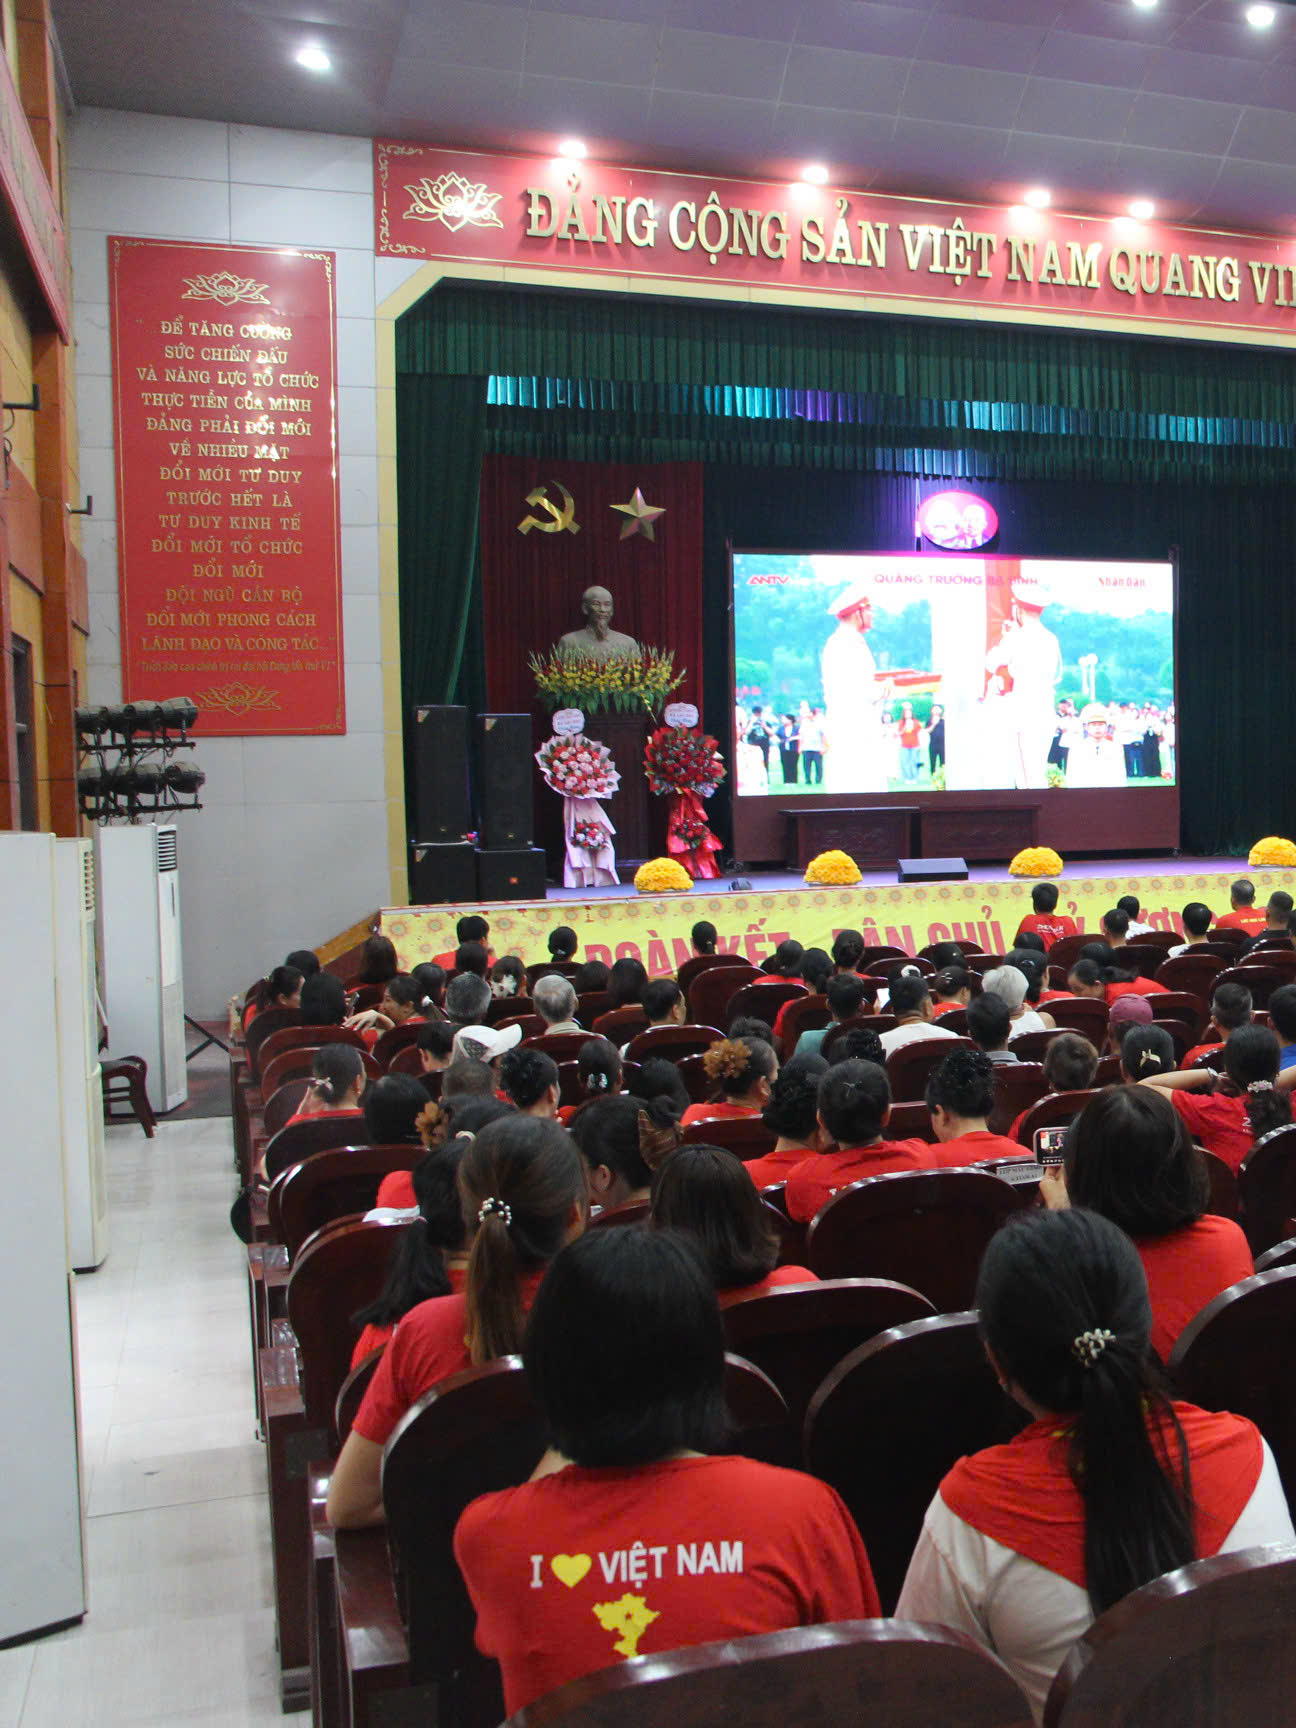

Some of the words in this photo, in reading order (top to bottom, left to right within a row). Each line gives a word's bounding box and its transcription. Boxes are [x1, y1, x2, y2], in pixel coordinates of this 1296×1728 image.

[525, 172, 659, 248] ĐẢNG
[668, 191, 791, 265] CỘNG
[801, 197, 888, 269] SẢN
[899, 217, 998, 287] VIỆT
[1006, 237, 1103, 288] NAM
[1109, 246, 1241, 303] QUANG
[161, 314, 183, 334] ĐỂ
[189, 322, 234, 337] TĂNG
[164, 342, 195, 359] SỨC
[201, 344, 251, 362] CHIẾN
[136, 364, 157, 381] VÀ
[165, 368, 210, 384] NĂNG
[217, 371, 247, 387] LỰC
[252, 367, 273, 386] TỔ
[279, 371, 320, 389] CHỨC
[142, 393, 184, 411] THỰC
[269, 395, 312, 412] MÌNH
[147, 412, 192, 432] ĐẢNG
[200, 415, 240, 434] PHẢI
[170, 439, 191, 456] VỀ
[198, 439, 248, 458] NHIỀU
[160, 460, 191, 480] ĐỔI
[198, 465, 230, 481] MỚI
[240, 468, 262, 482] TƯ
[268, 470, 302, 483] DUY
[167, 490, 221, 504] TRƯỚC
[231, 489, 263, 506] HẾT
[273, 491, 293, 507] LÀ
[159, 515, 181, 528] TƯ
[189, 516, 222, 528] DUY
[229, 517, 271, 529] KINH
[152, 532, 182, 552] ĐỔI
[191, 536, 222, 553] MỚI
[259, 538, 303, 554] CHỨC
[193, 556, 223, 577] ĐỔI
[232, 559, 264, 578] MỚI
[217, 613, 270, 627] PHONG
[530, 1554, 543, 1588] I
[598, 1541, 668, 1588] VIỆT
[677, 1541, 744, 1576] NAM
